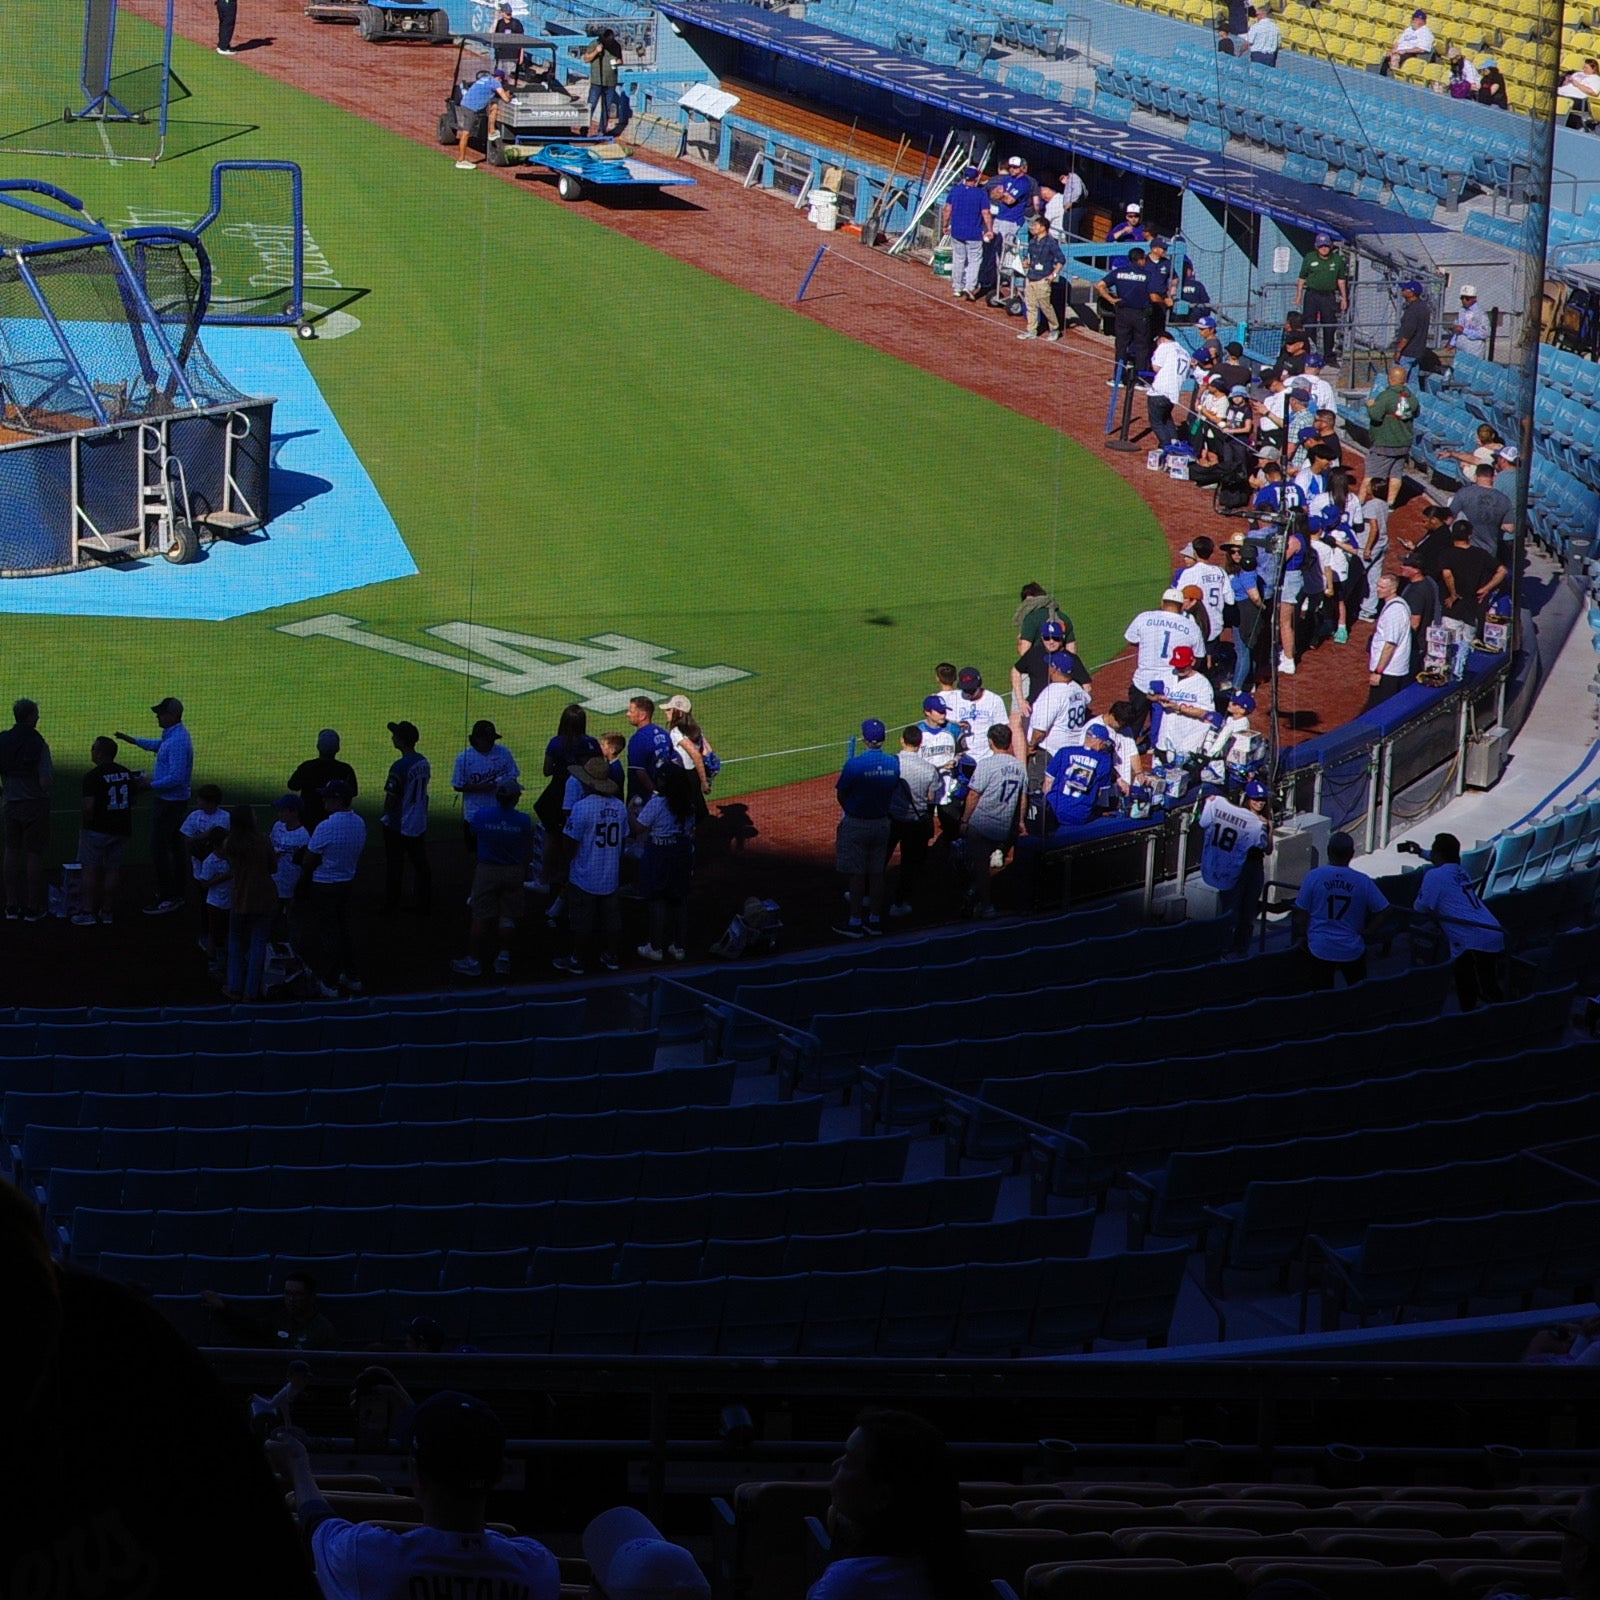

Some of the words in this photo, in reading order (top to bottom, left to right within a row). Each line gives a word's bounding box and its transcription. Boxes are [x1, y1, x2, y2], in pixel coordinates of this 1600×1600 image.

[1209, 587, 1220, 607] 5
[1146, 618, 1191, 636] GUANACO
[1161, 630, 1169, 659] 1
[1067, 704, 1087, 730] 88
[107, 783, 130, 811] 11
[1000, 779, 1019, 802] 17
[596, 822, 621, 847] 50
[1211, 822, 1238, 853] 18
[1326, 894, 1352, 921] 17
